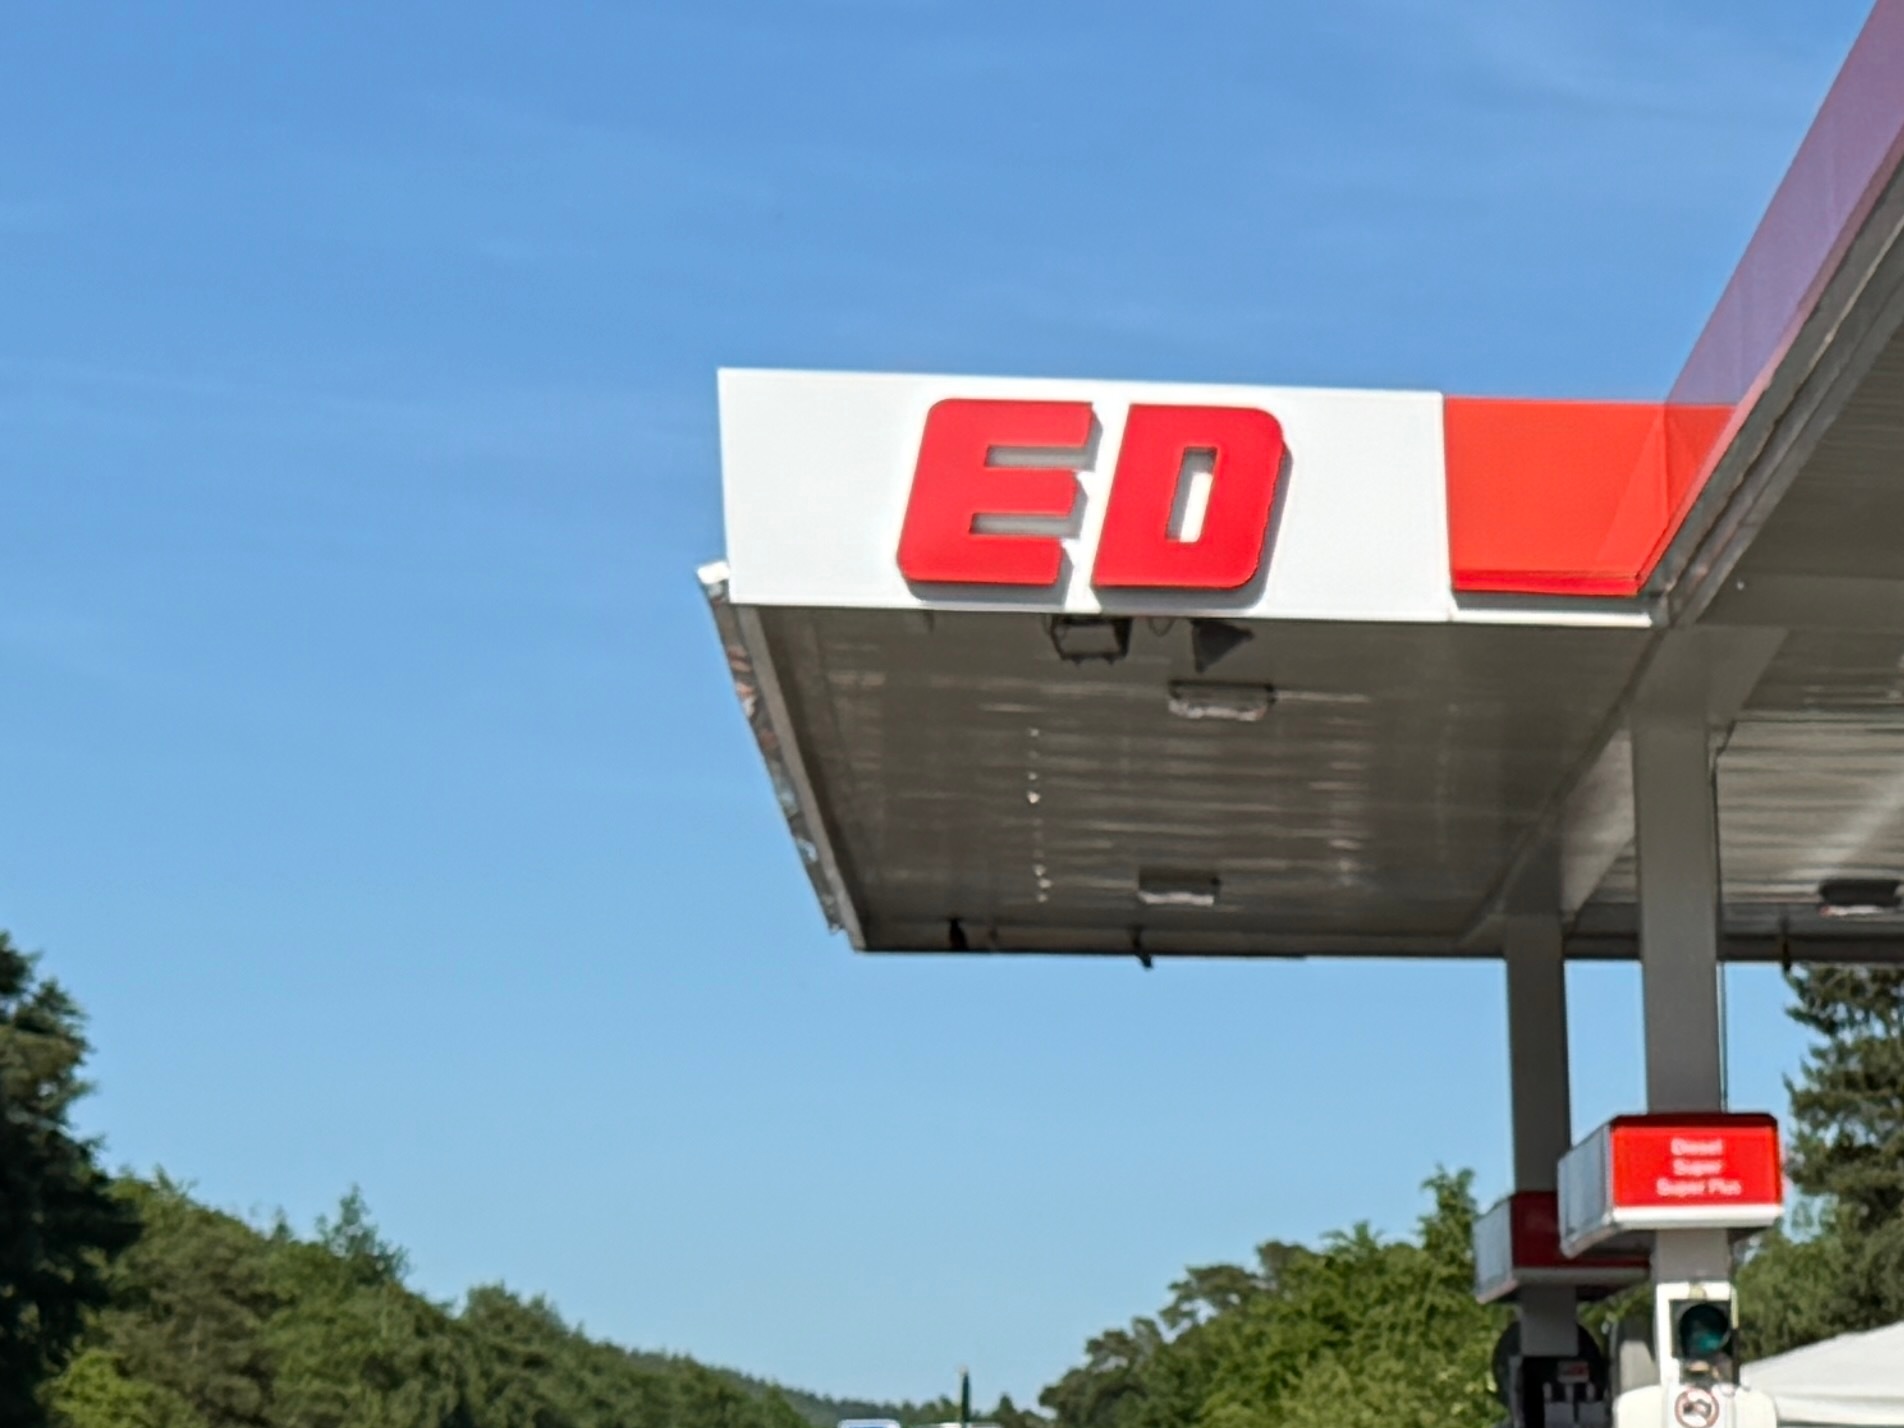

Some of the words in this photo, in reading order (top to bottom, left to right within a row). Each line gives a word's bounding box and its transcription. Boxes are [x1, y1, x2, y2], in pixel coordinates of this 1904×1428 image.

[897, 398, 1289, 590] ED
[1671, 1138, 1723, 1156] Diesel
[1672, 1159, 1721, 1176] Super
[1656, 1177, 1706, 1197] Super
[1708, 1177, 1742, 1195] Plus
